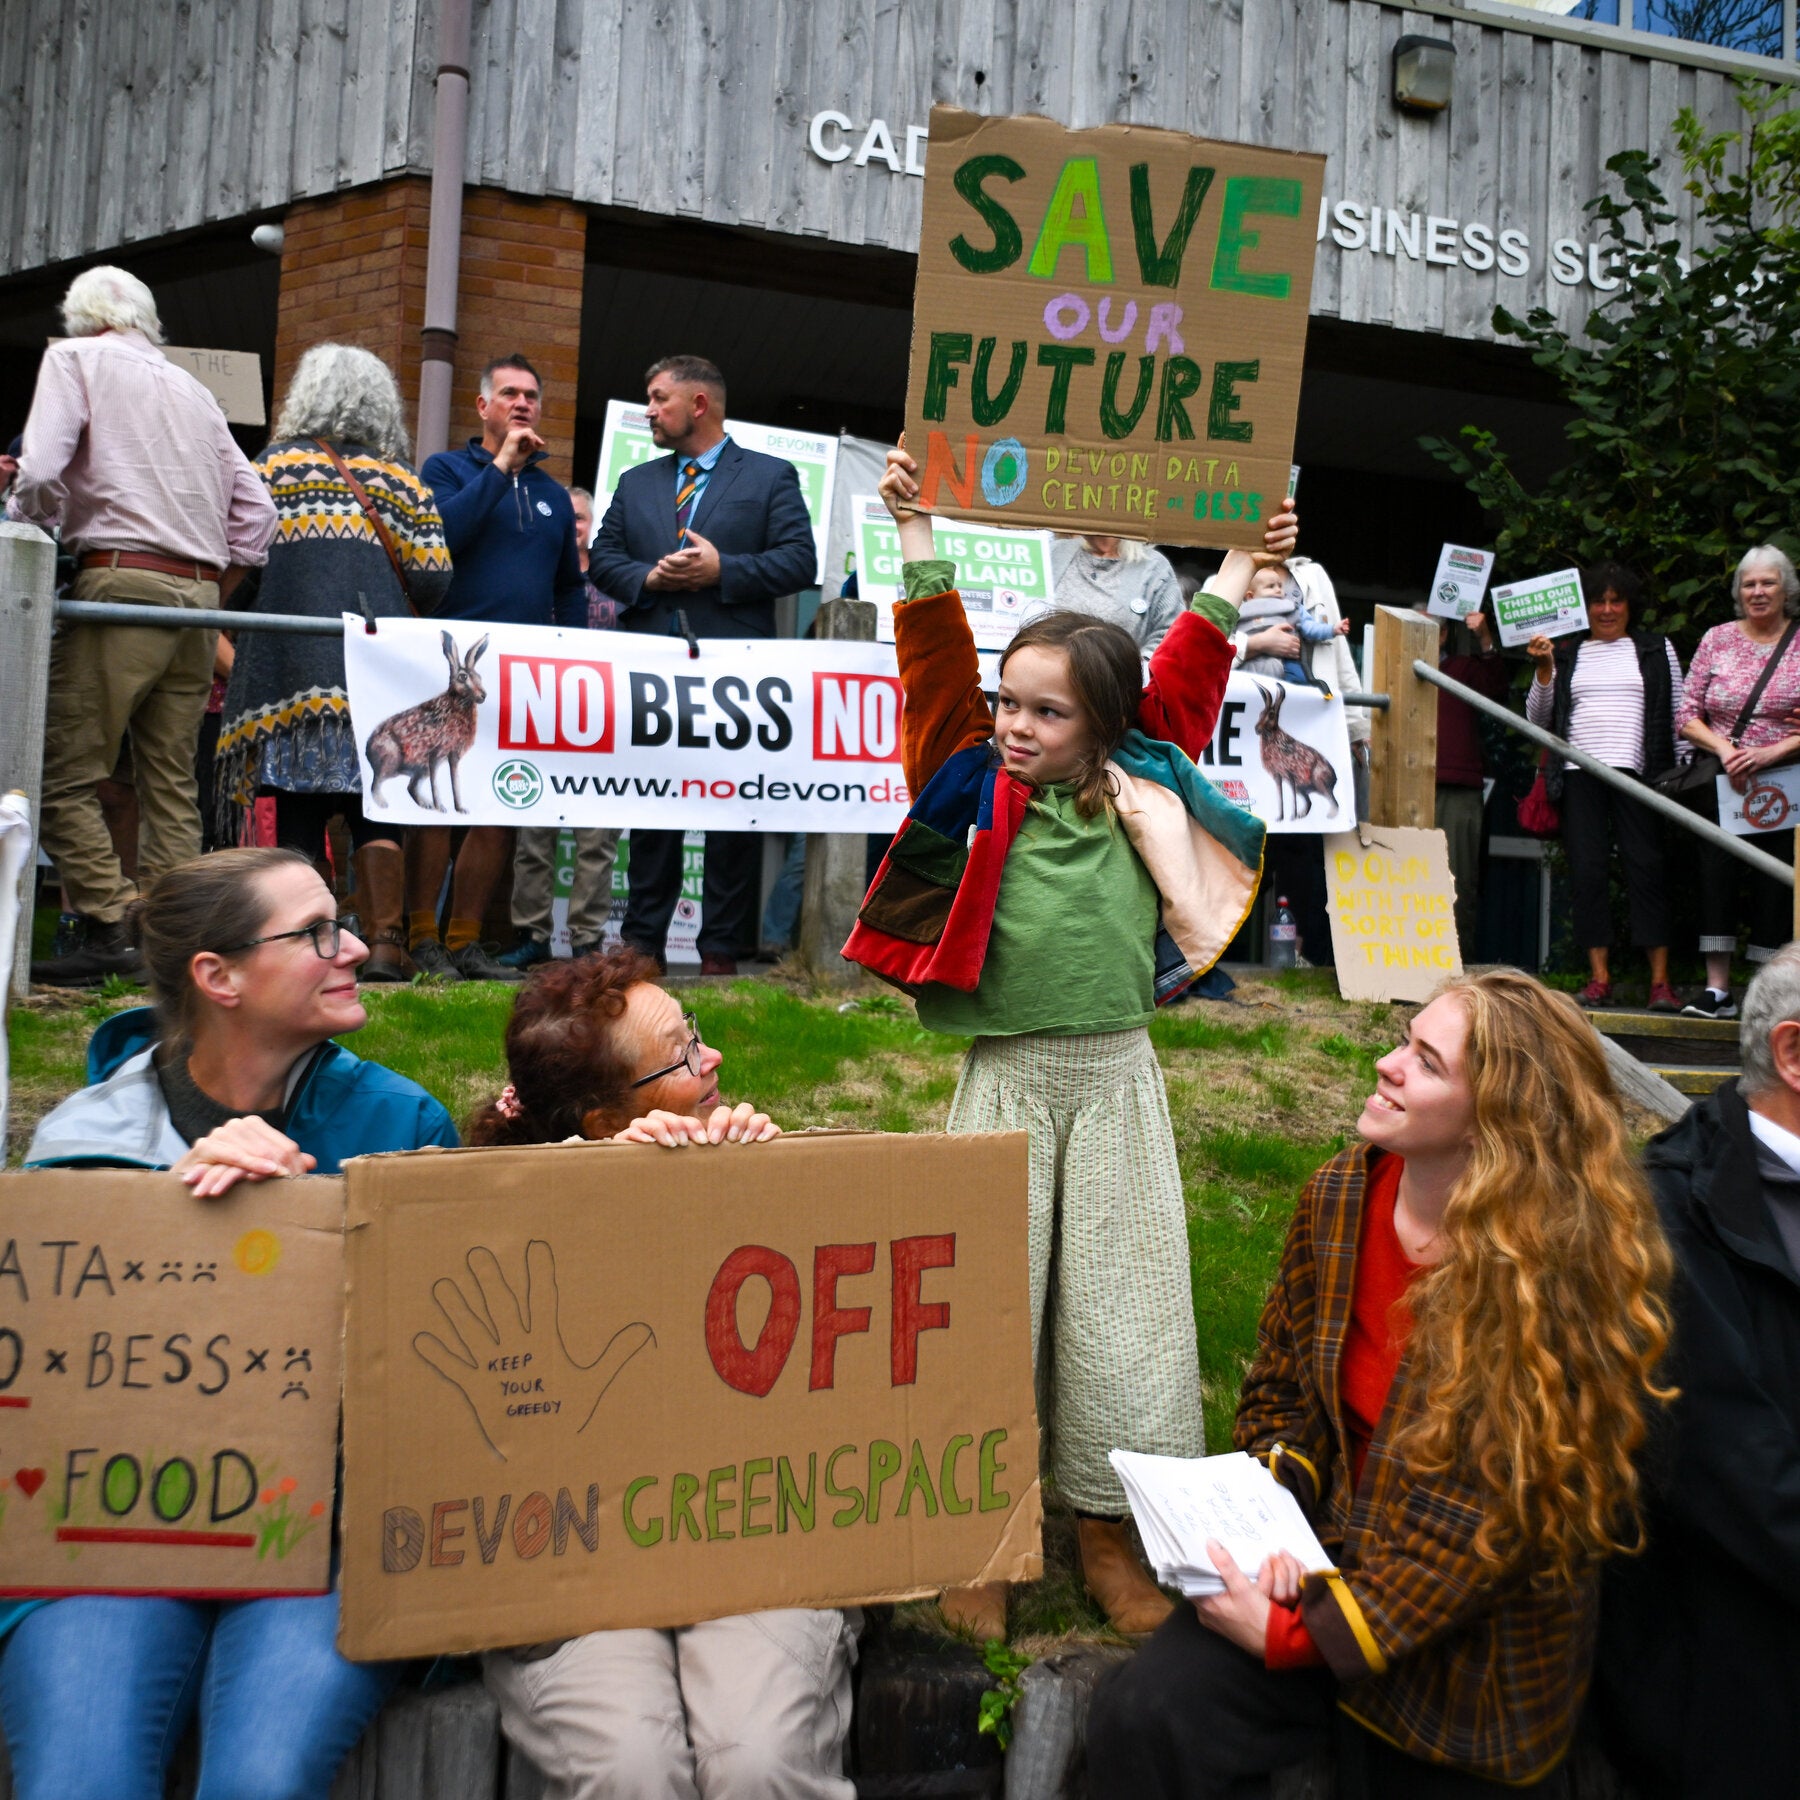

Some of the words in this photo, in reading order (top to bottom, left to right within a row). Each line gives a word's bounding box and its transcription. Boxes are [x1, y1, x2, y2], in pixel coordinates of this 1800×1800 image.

[948, 154, 1303, 299] SAVE
[1044, 293, 1184, 355] OUR
[190, 352, 232, 376] THE
[923, 332, 1260, 443] FUTURE
[919, 431, 1028, 508] NO
[1046, 446, 1148, 480] DEVON
[1166, 456, 1240, 487] DATA
[1042, 479, 1160, 520] CENTRE
[1194, 491, 1264, 523] BESS
[945, 537, 967, 557] IS
[975, 541, 1031, 563] OUR
[1502, 596, 1531, 609] THIS
[1534, 592, 1545, 602] IS
[1547, 586, 1572, 599] OUR
[510, 662, 605, 748] NO
[630, 671, 792, 751] BESS
[822, 680, 897, 757] NO
[550, 773, 909, 803] www.nodevonda
[1334, 851, 1429, 885] DOWN
[1336, 888, 1393, 910] WITH
[1401, 893, 1449, 913] THIS
[1341, 914, 1407, 937] SORT
[1416, 918, 1450, 938] OF
[1360, 942, 1455, 969] THING
[0, 1239, 116, 1301] ATA
[705, 1233, 956, 1397] OFF
[86, 1331, 231, 1395] BESS
[488, 1353, 532, 1371] KEEP
[501, 1378, 544, 1396] YOUR
[506, 1400, 561, 1416] GREEDY
[64, 1448, 258, 1522] FOOD
[383, 1483, 600, 1573] DEVON
[622, 1428, 1010, 1547] GREENSPACE
